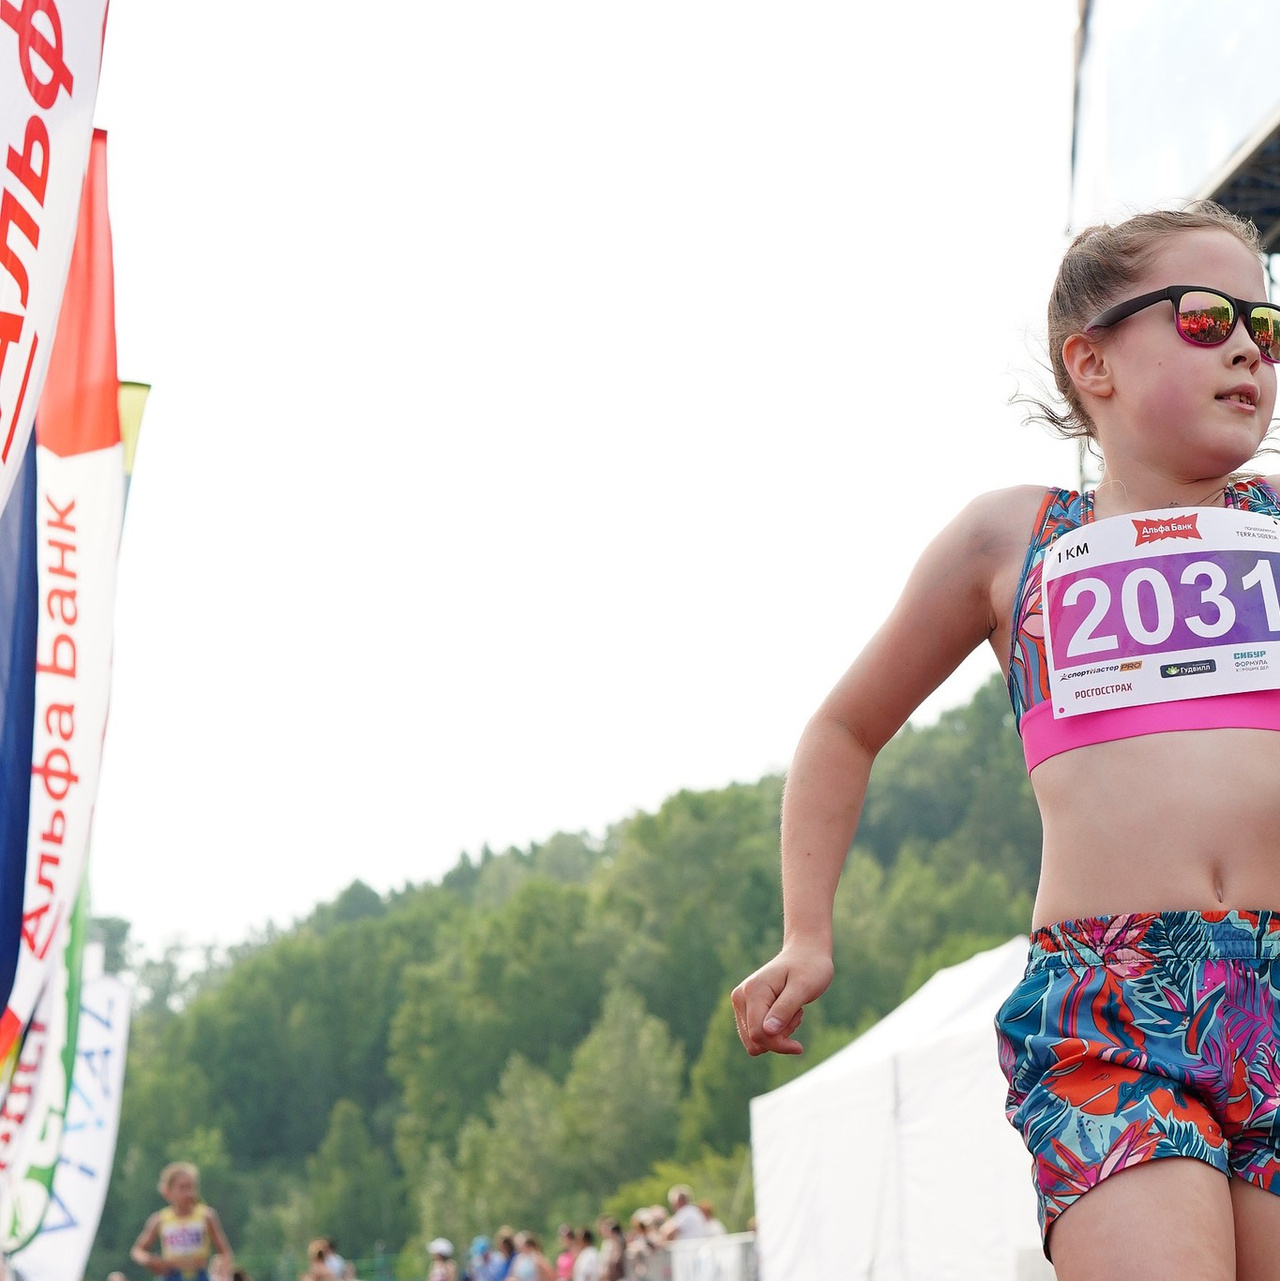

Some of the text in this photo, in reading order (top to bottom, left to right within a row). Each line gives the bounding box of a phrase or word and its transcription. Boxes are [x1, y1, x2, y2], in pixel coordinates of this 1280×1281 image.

[1142, 522, 1193, 538] Альфа Банк
[1057, 551, 1063, 563] 1
[1233, 650, 1267, 660] СИБУР
[1120, 661, 1141, 670] PRO
[1234, 659, 1268, 668] ФОРМУЛА
[1074, 682, 1133, 700] РОСГОССТРАХ
[19, 702, 79, 960] Альфа
